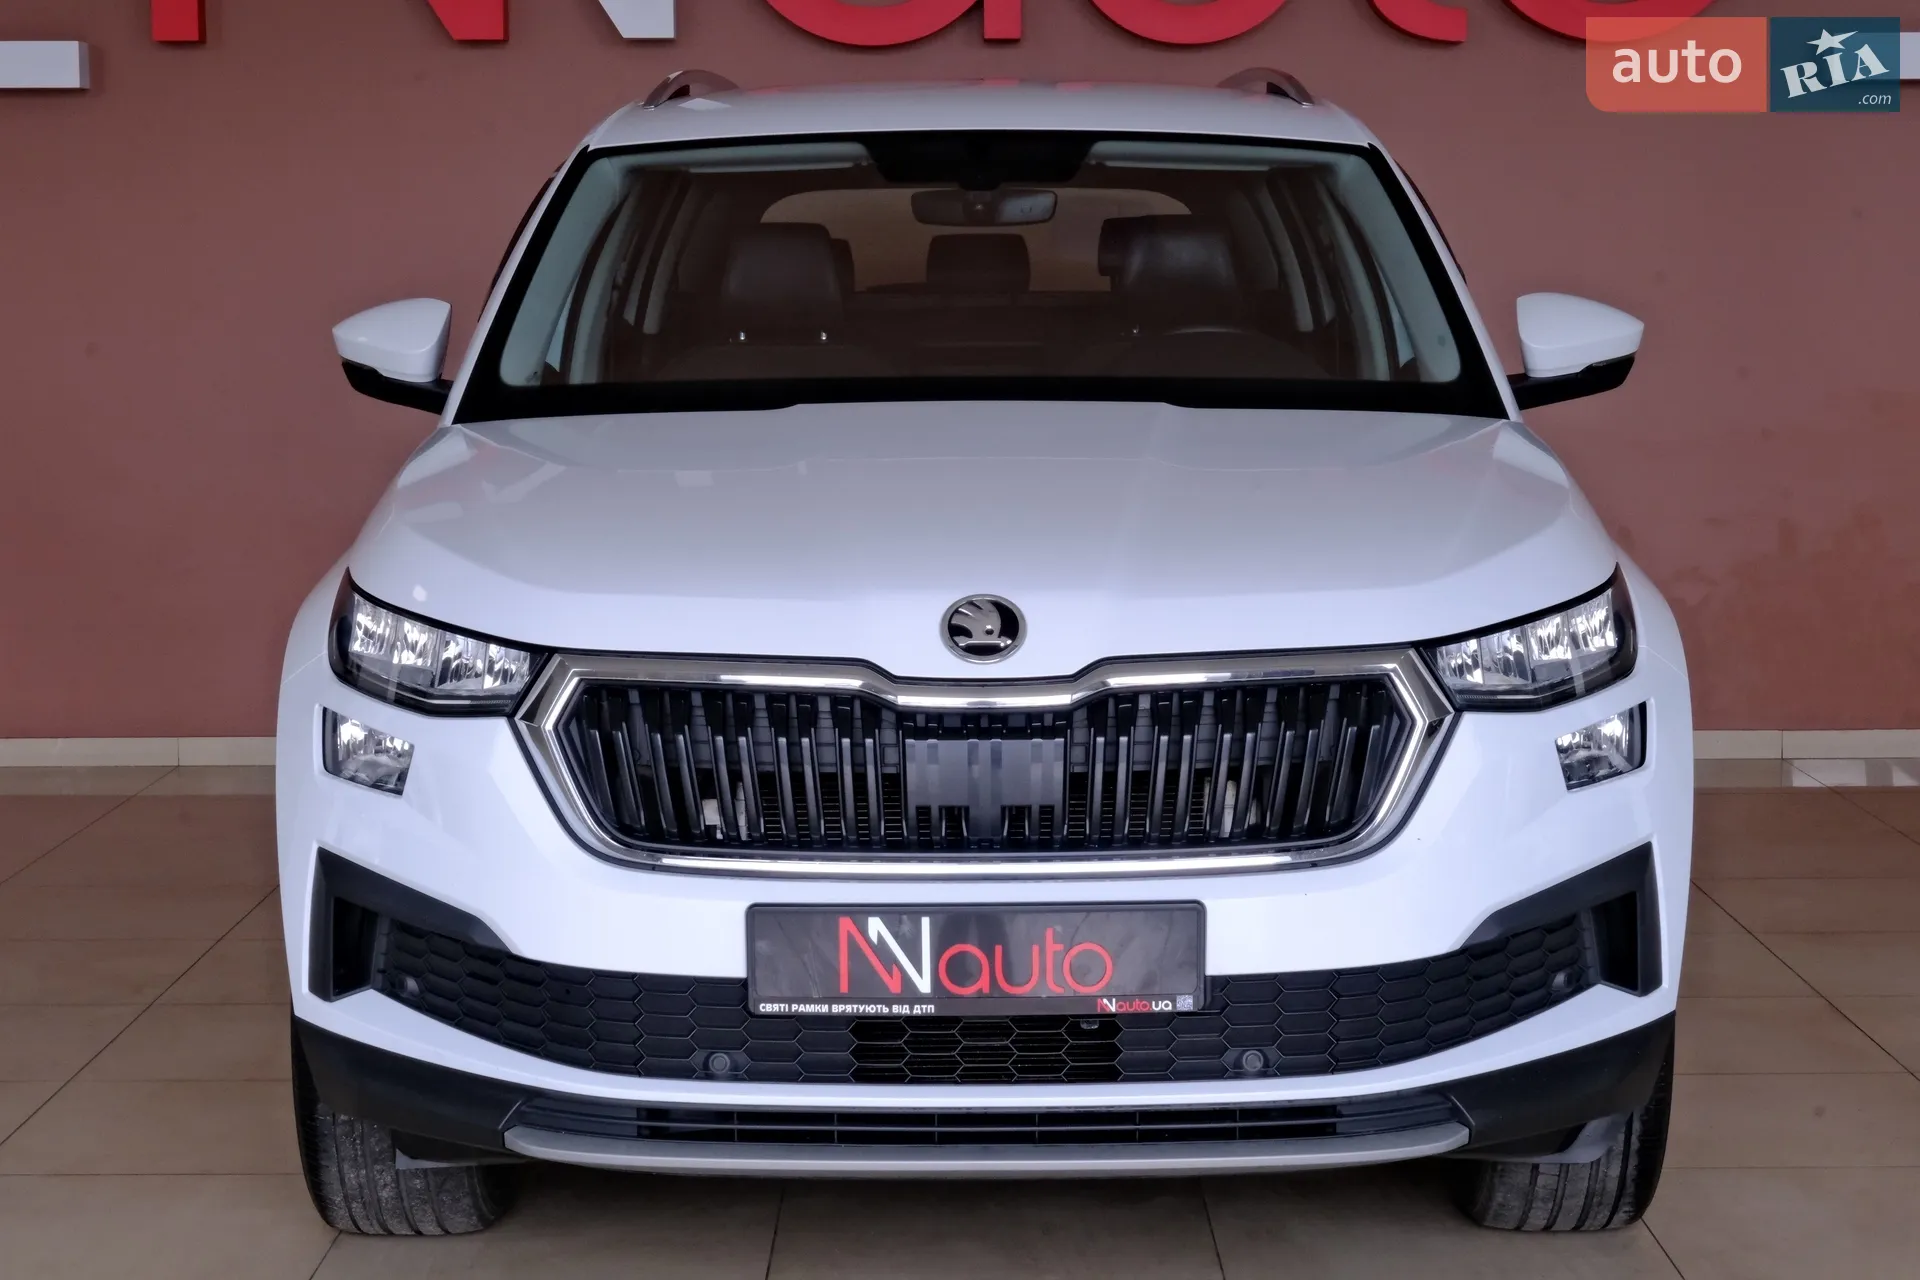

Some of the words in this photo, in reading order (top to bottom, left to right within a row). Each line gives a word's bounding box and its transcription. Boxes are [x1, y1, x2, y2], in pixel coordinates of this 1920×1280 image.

[759, 1003, 788, 1012] СВЯТІ
[791, 1004, 829, 1013] РАМКИ
[832, 1004, 889, 1014] ВРЯТУЮТЬ
[892, 1004, 910, 1014] ВІД
[913, 1004, 935, 1014] ДТП
